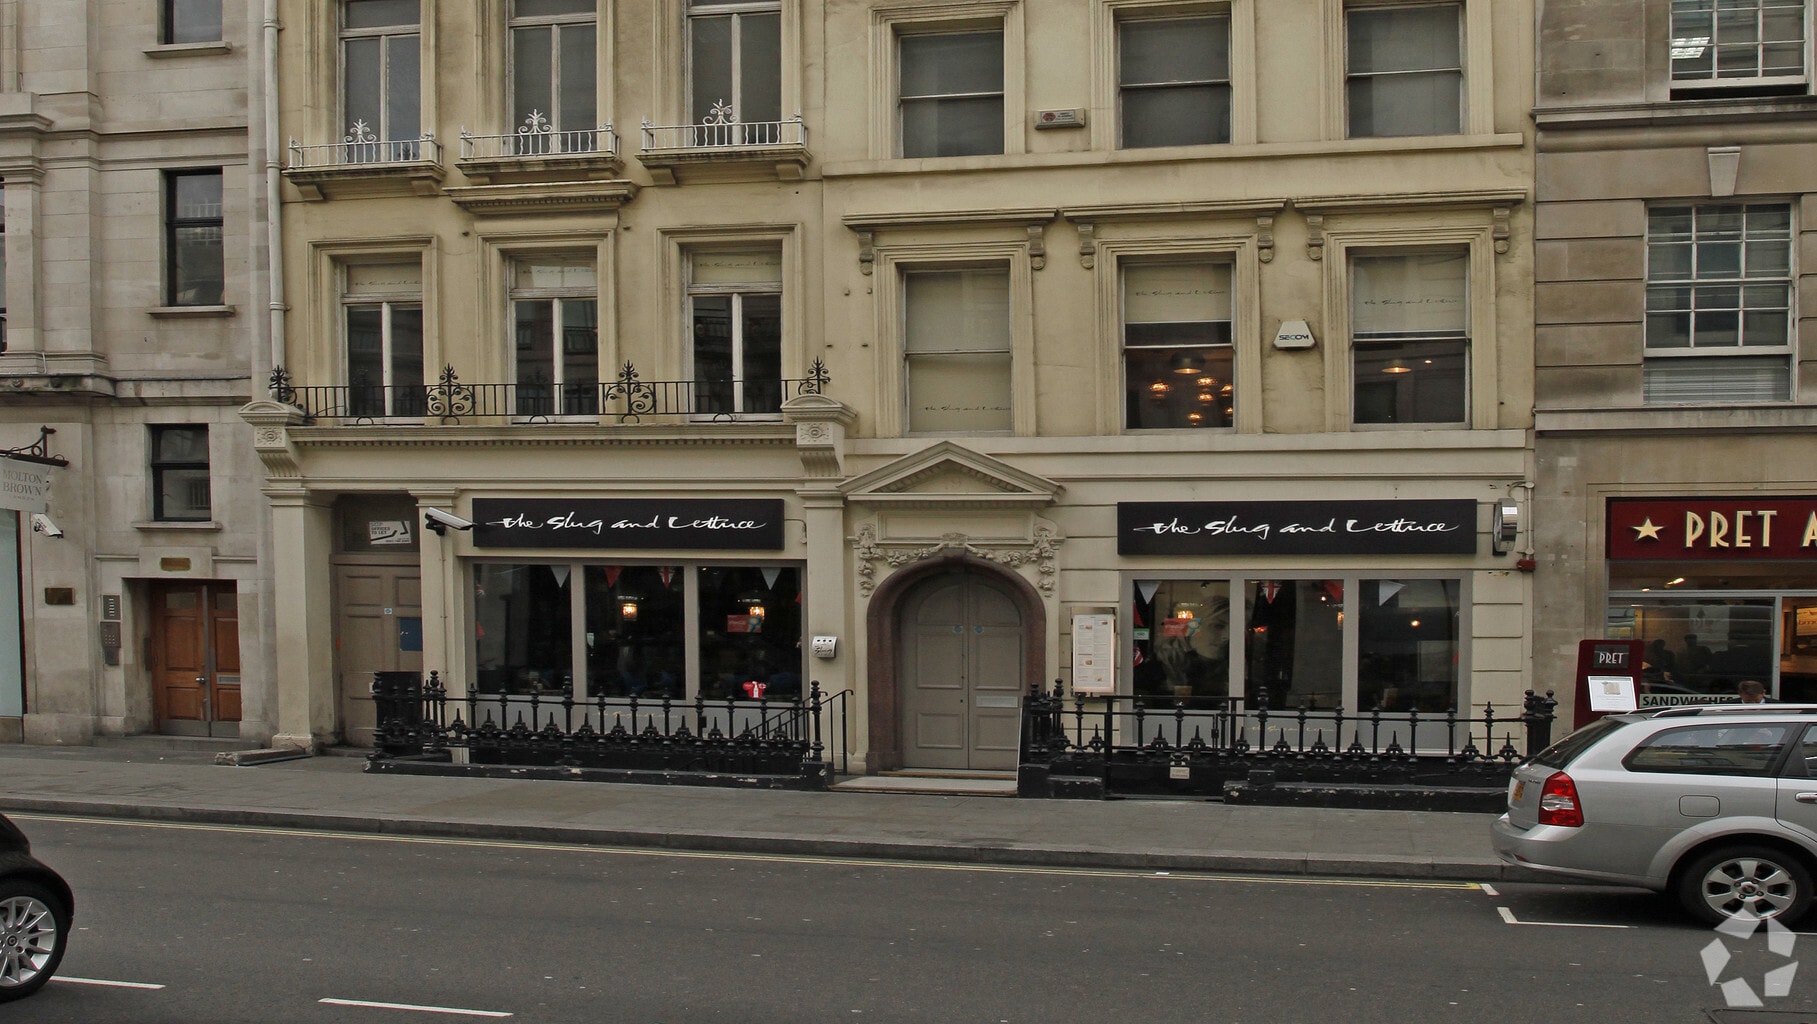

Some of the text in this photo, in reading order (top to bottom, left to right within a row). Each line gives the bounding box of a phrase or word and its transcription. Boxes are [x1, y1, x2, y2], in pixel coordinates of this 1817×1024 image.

[3, 481, 42, 496] BROWN
[485, 511, 767, 535] the Slug and Lettuce
[1133, 515, 1460, 540] the Slug and Lettuce
[1686, 510, 1778, 547] PRET
[1599, 652, 1624, 664] PRET
